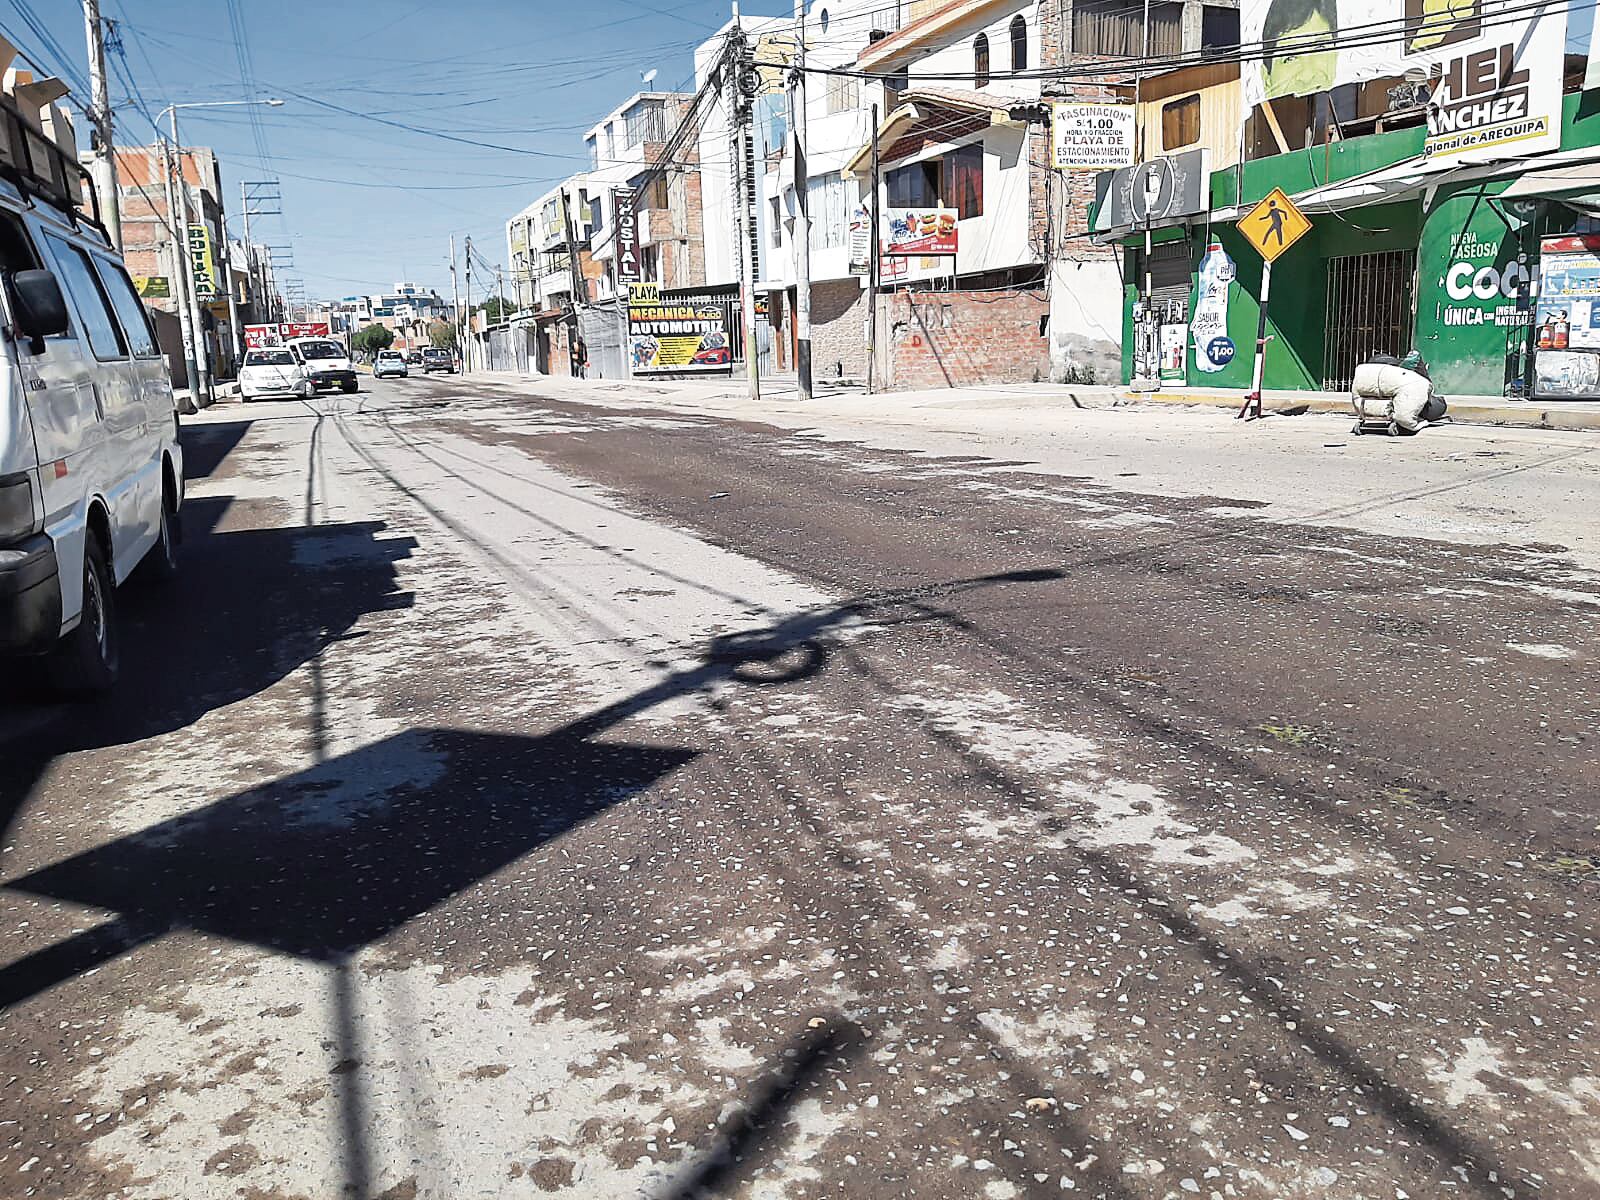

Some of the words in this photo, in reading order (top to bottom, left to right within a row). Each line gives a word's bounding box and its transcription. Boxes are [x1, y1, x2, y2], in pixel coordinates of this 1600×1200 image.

[1064, 136, 1104, 145] PLAYA
[1108, 136, 1124, 145] DE
[1463, 136, 1477, 146] de
[1479, 120, 1544, 143] AREQUIPA
[1057, 147, 1130, 156] ESTACIONAMIENTO
[619, 199, 636, 275] HOSTAL
[188, 230, 212, 292] BOTICA
[628, 286, 659, 300] PLAYA
[629, 306, 696, 320] MECANICA
[1444, 305, 1484, 326] ÚNICA
[630, 320, 724, 336] AUTOMOTRIZ
